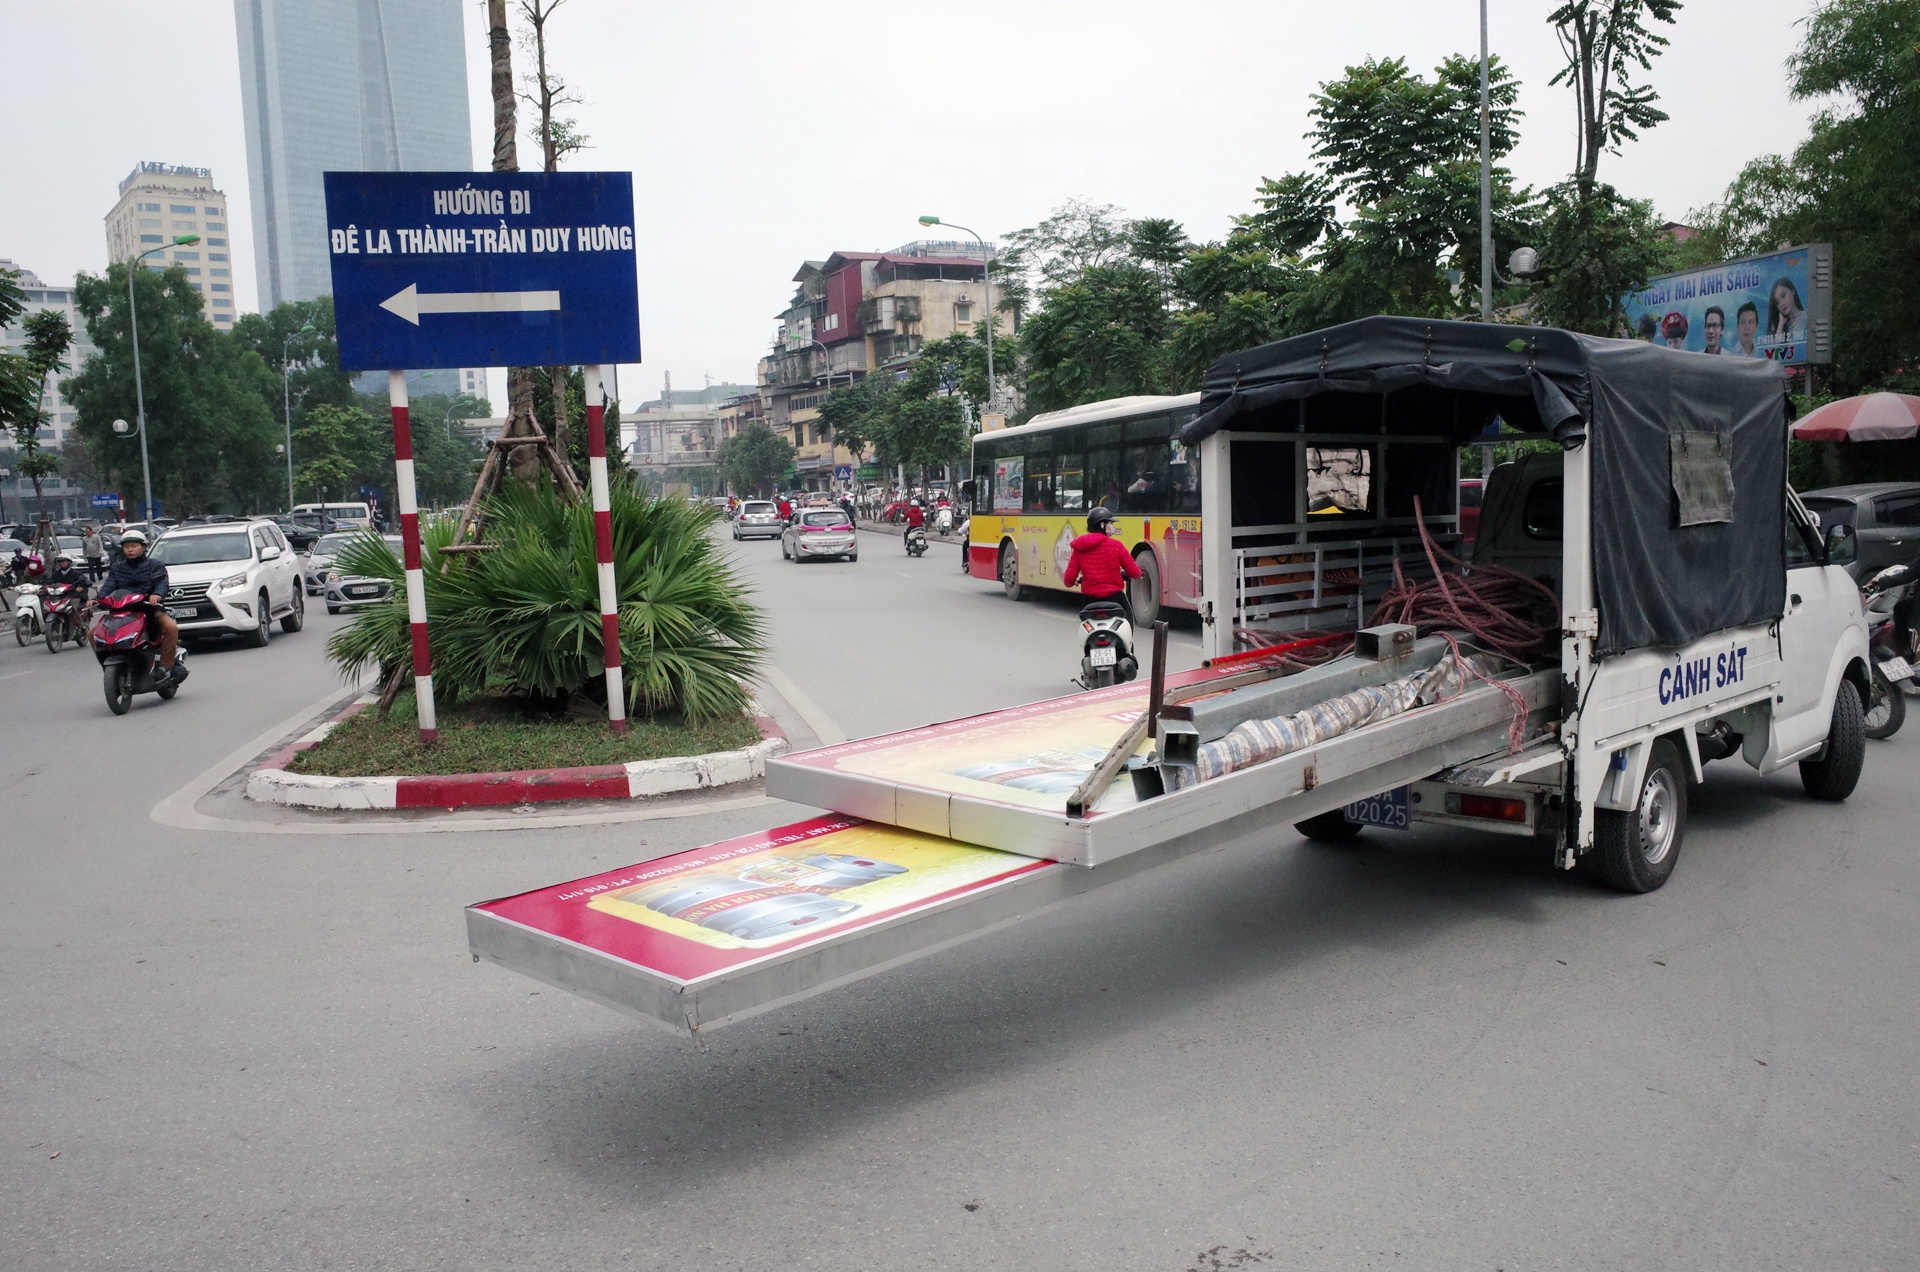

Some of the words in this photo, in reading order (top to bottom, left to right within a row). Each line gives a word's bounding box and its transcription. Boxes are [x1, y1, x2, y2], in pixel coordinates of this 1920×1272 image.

[433, 182, 504, 216] HƯỚNG
[509, 190, 531, 215] ĐI
[331, 223, 360, 255] ĐÊ
[365, 229, 393, 255] LA
[531, 228, 571, 253] DUY
[577, 225, 633, 252] HƯNG
[925, 240, 958, 250] SUNNY
[964, 241, 996, 251] HOTEL
[1675, 278, 1696, 301] MAI
[1699, 272, 1723, 297] ÁNH
[1764, 345, 1795, 361] VTV3
[1092, 656, 1115, 666] 378.62
[1658, 652, 1711, 705] CẢNH
[1716, 641, 1748, 688] SÁT
[775, 834, 802, 844] TEL:
